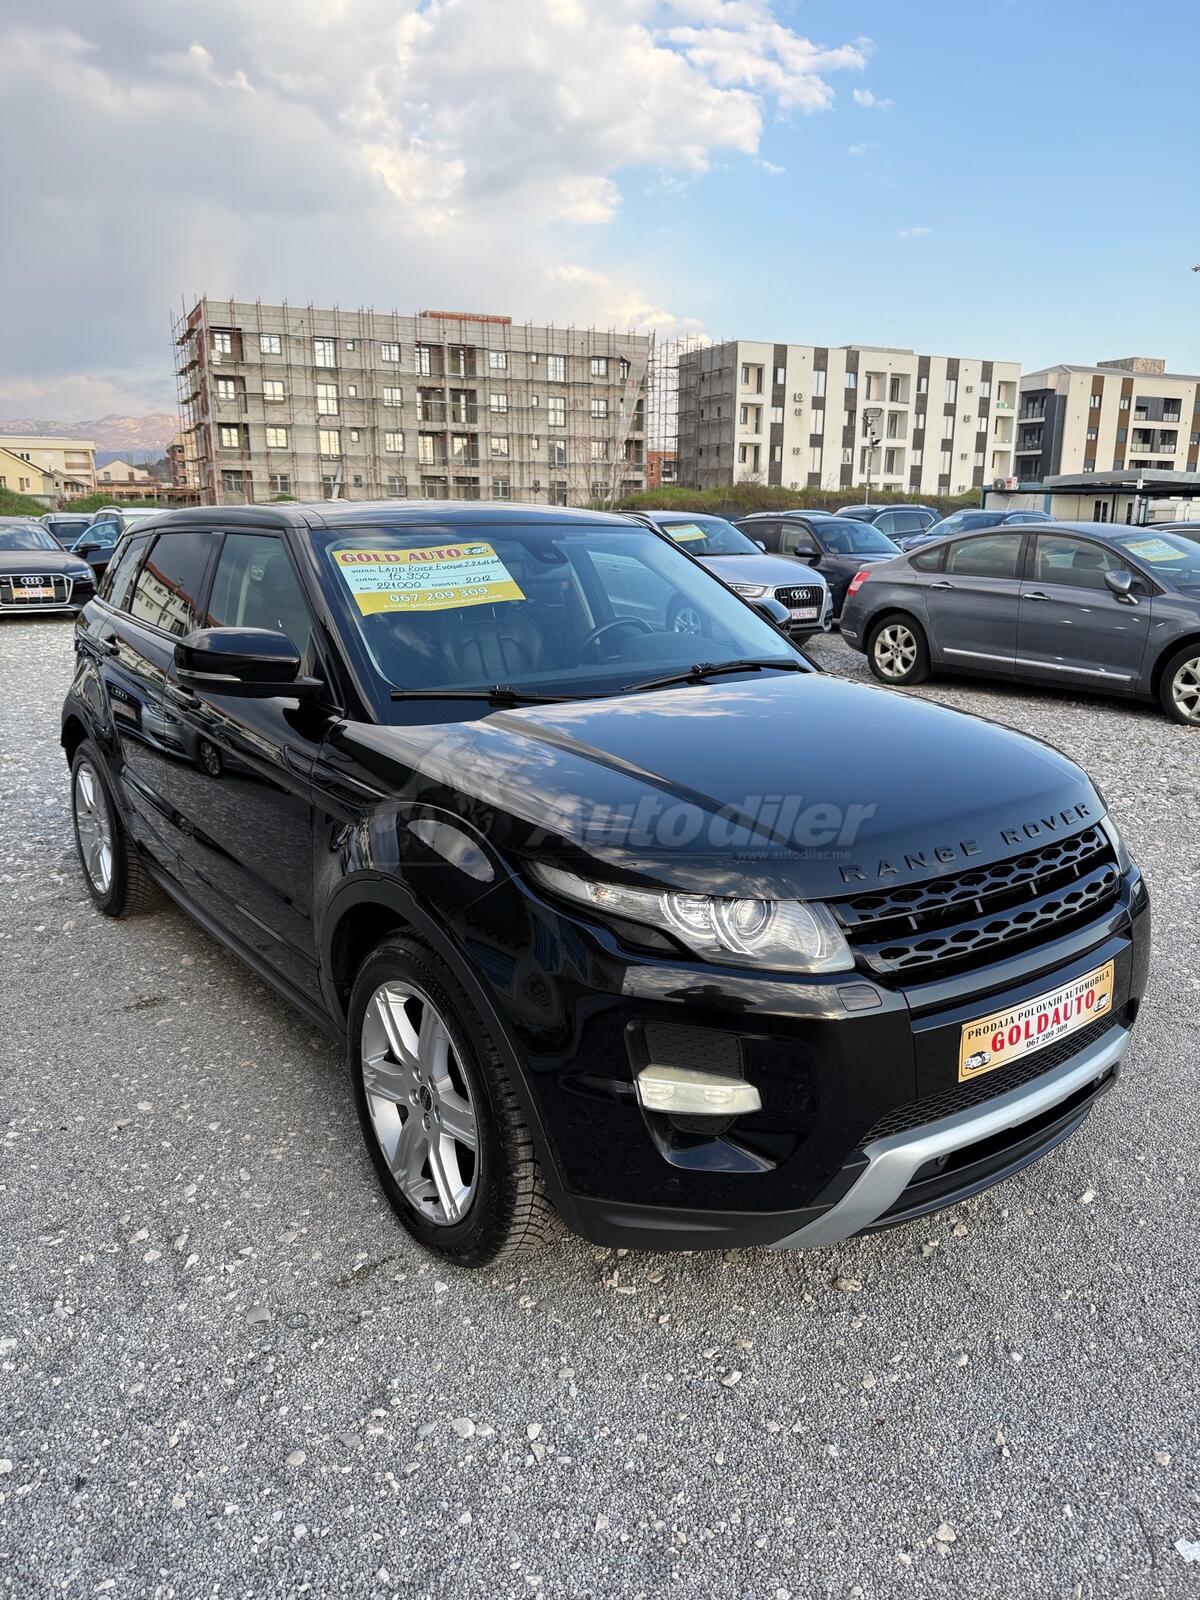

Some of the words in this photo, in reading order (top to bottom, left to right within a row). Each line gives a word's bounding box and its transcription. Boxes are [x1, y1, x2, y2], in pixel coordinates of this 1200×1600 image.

[340, 553, 401, 563] GOLD
[408, 548, 462, 562] AUTO
[838, 838, 983, 883] RANGE
[1000, 801, 1092, 846] ROVER
[967, 1016, 1015, 1040] PRODAJA
[1017, 996, 1063, 1022] POLOVNIH
[1064, 970, 1110, 1001] AUTOMOBILA
[991, 989, 1095, 1052] GOLDAUTO
[1026, 1036, 1040, 1049] 067
[1041, 1029, 1055, 1043] 209
[1055, 1023, 1068, 1036] 309
